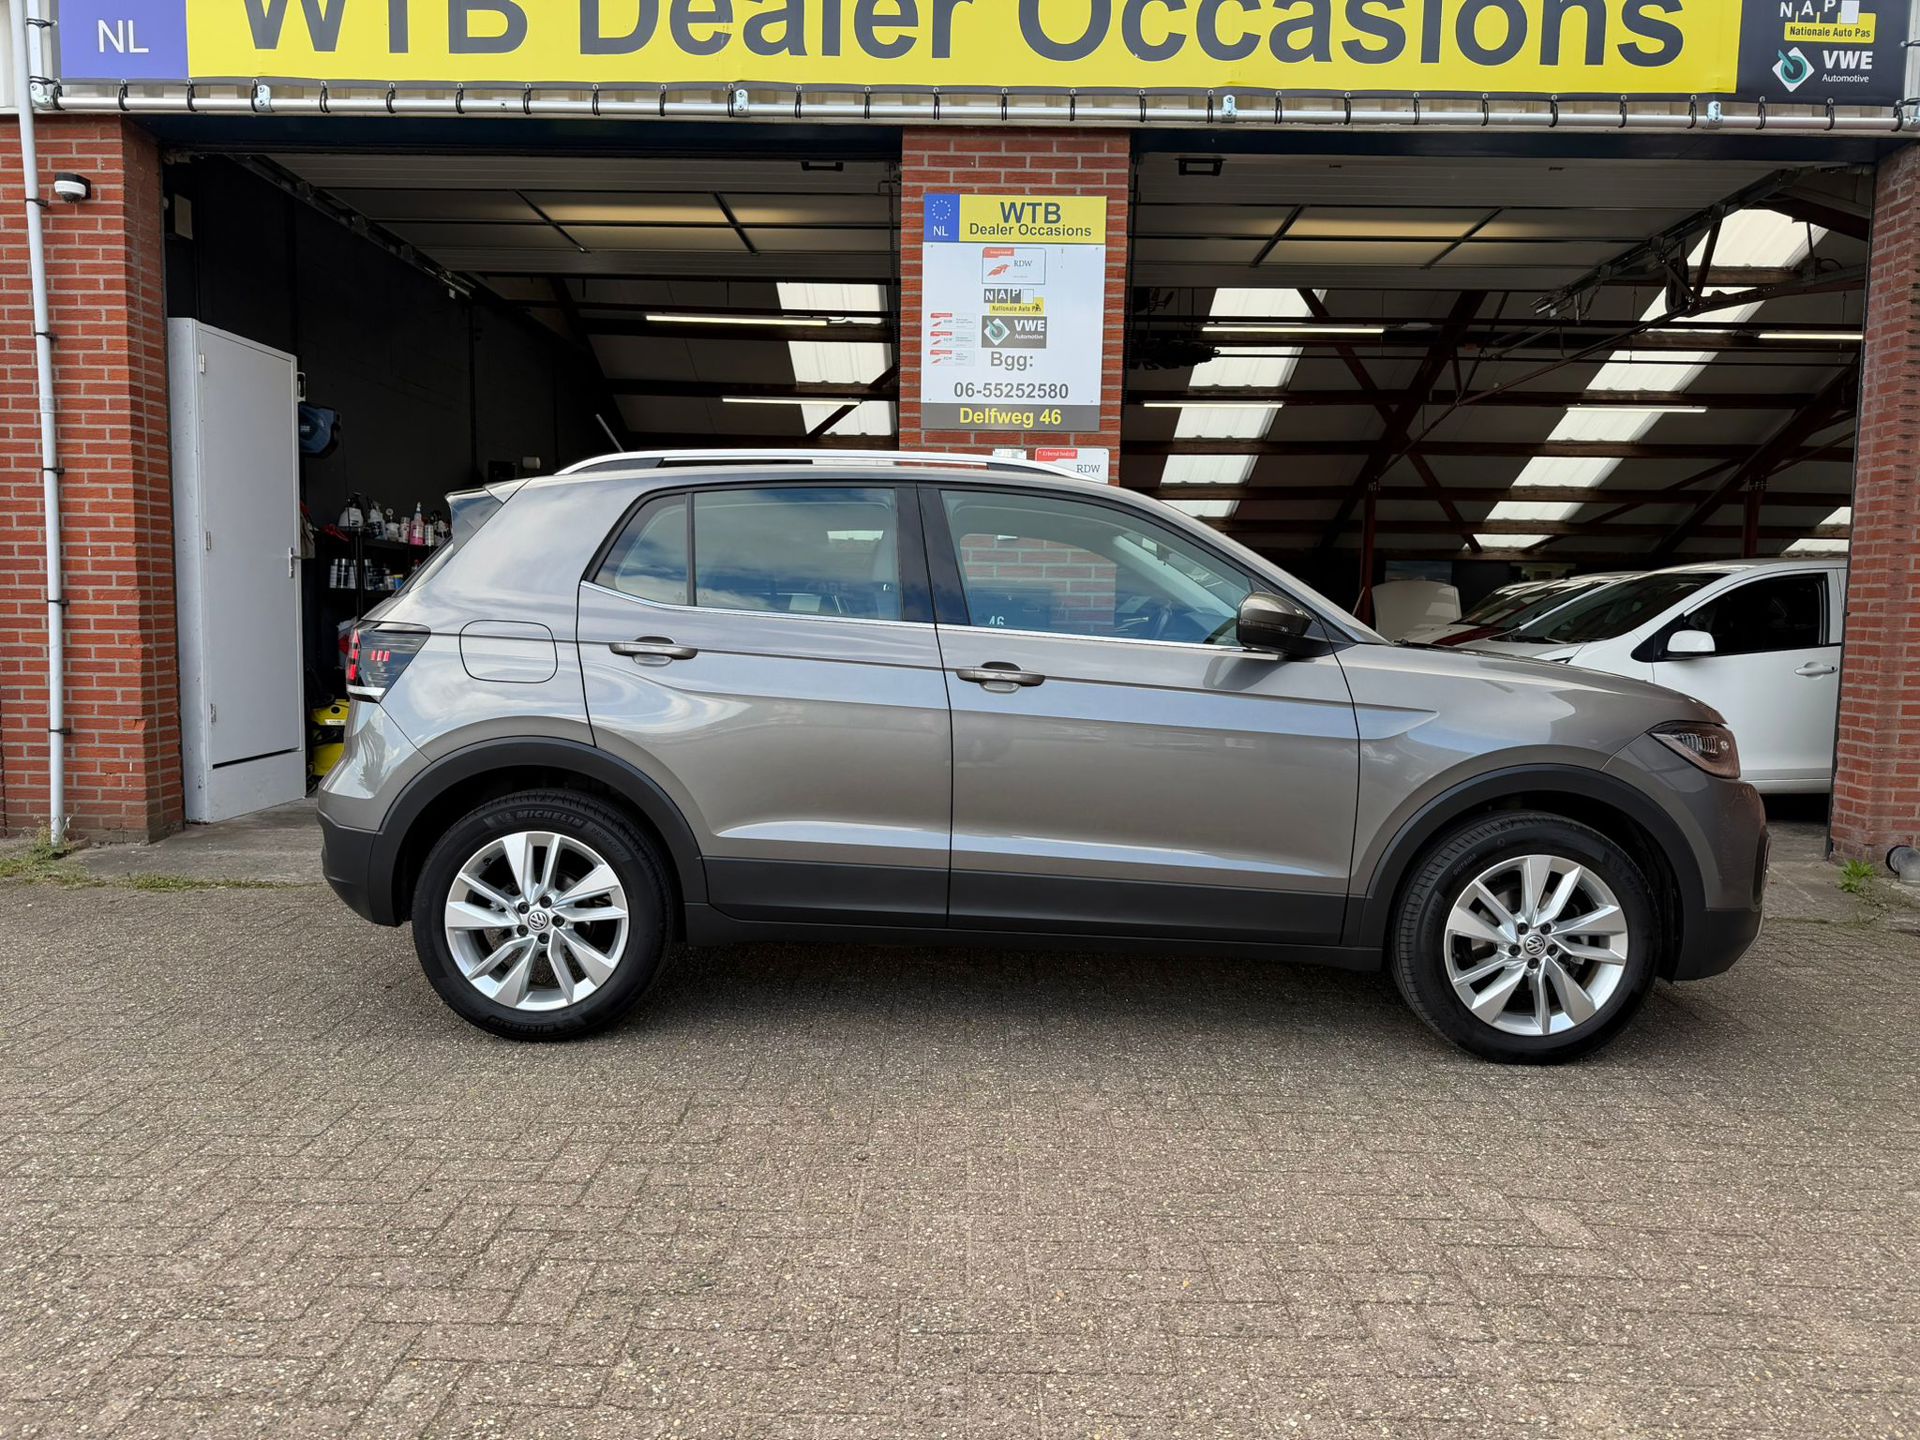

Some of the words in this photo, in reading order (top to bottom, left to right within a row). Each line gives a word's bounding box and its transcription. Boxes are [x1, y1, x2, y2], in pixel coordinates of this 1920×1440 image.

[97, 20, 149, 53] NL
[579, 0, 974, 59] Dealer
[1018, 0, 1685, 67] Occasions
[1789, 26, 1831, 37] Nationale
[1832, 28, 1853, 38] Auto
[1855, 28, 1871, 38] Pas
[1822, 50, 1873, 70] VWE
[1822, 73, 1869, 83] Automotive
[1000, 201, 1061, 224] WTB
[933, 225, 949, 236] NL
[969, 222, 1014, 236] Dealer
[1018, 224, 1092, 237] Occasions
[1014, 319, 1045, 332] VWE
[990, 351, 1034, 371] Bgg:
[953, 381, 1069, 399] 06-55252580
[959, 407, 1034, 428] Delfweg
[1039, 408, 1062, 425] 46
[1076, 464, 1101, 473] RDW
[515, 809, 585, 828] MICHELIN
